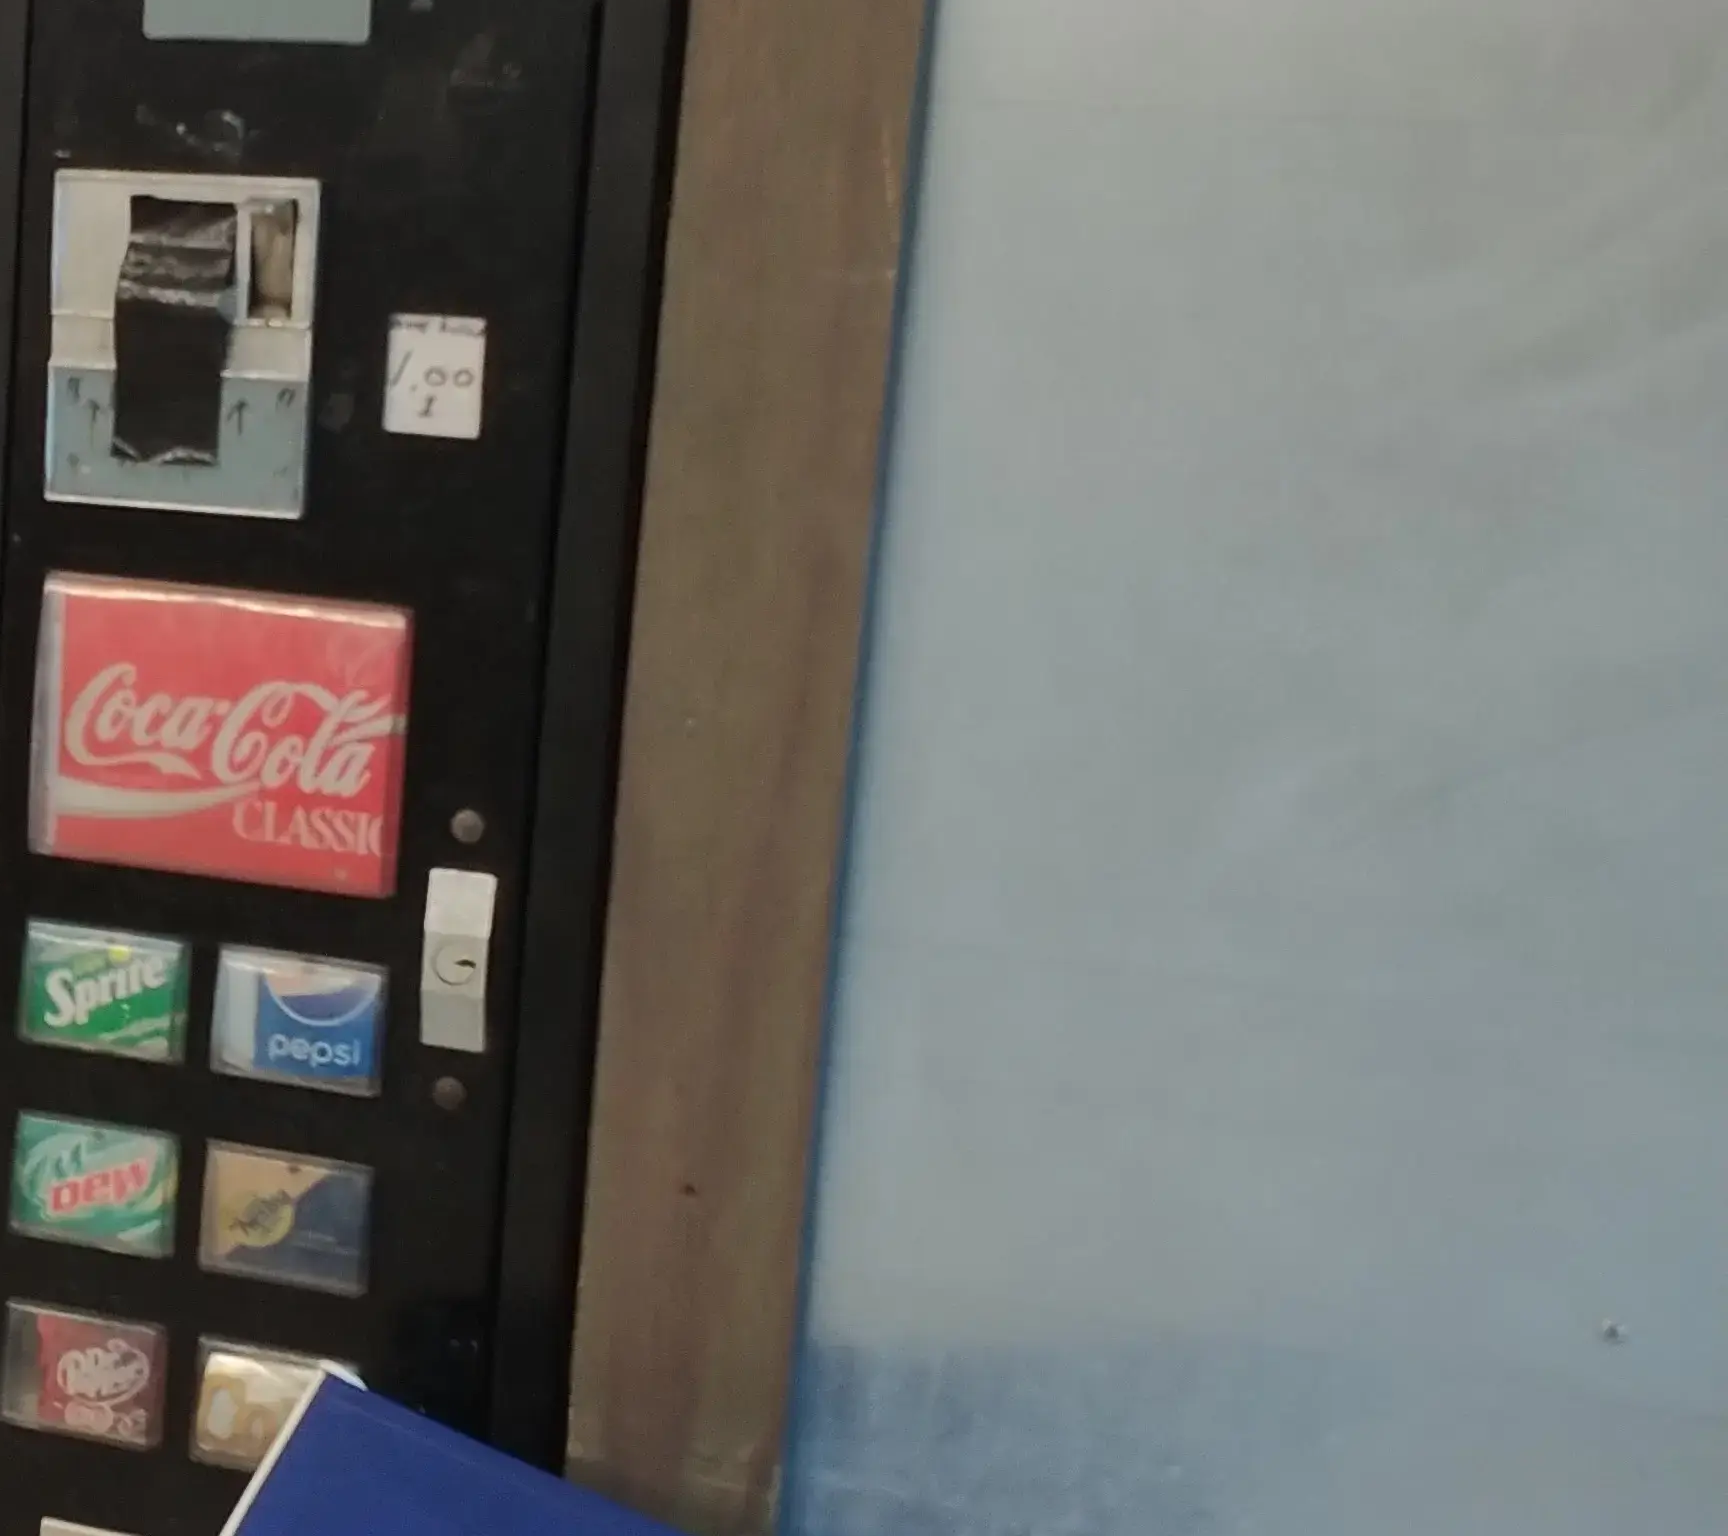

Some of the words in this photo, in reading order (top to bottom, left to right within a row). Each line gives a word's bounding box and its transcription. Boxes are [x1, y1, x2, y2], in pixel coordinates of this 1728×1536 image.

[65, 661, 385, 798] Coca-Cola
[43, 954, 169, 1028] Sprite
[268, 1033, 361, 1068] pepsi
